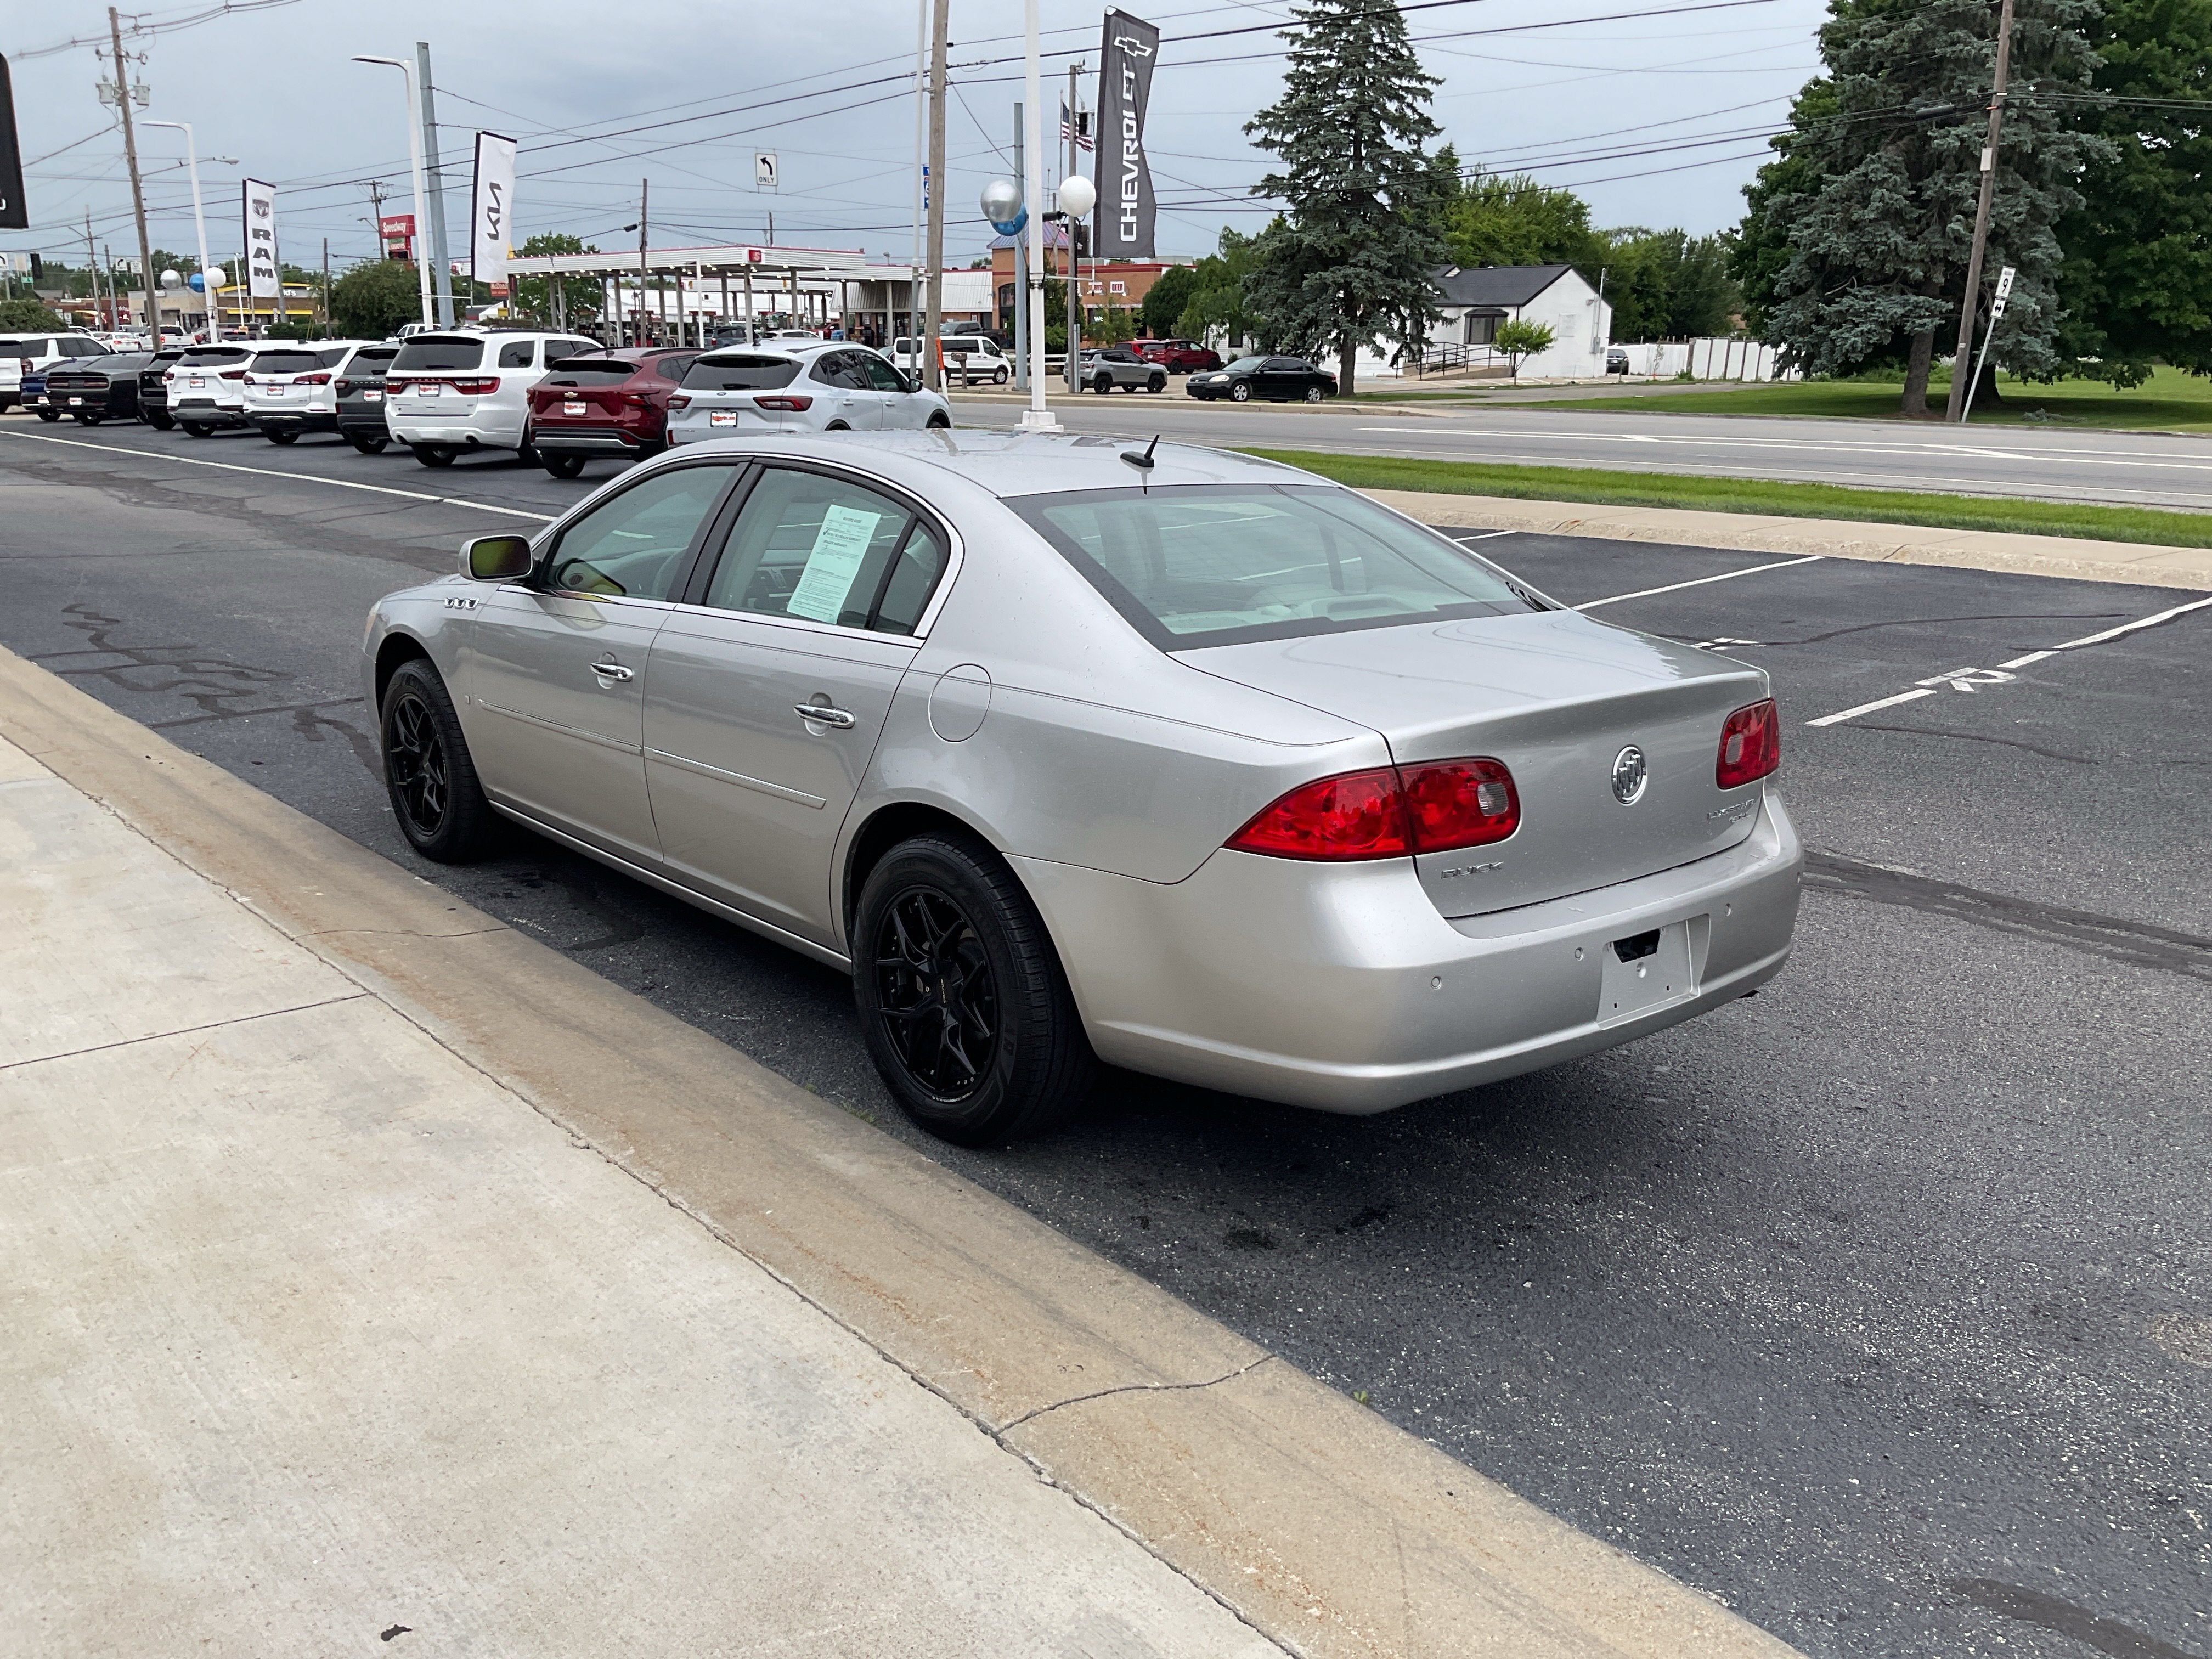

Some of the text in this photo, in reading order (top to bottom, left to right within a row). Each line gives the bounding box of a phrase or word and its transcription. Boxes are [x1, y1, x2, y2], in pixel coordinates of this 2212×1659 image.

[252, 228, 274, 278] RAM
[2002, 278, 2008, 294] 9
[1441, 861, 1504, 879] BUICK
